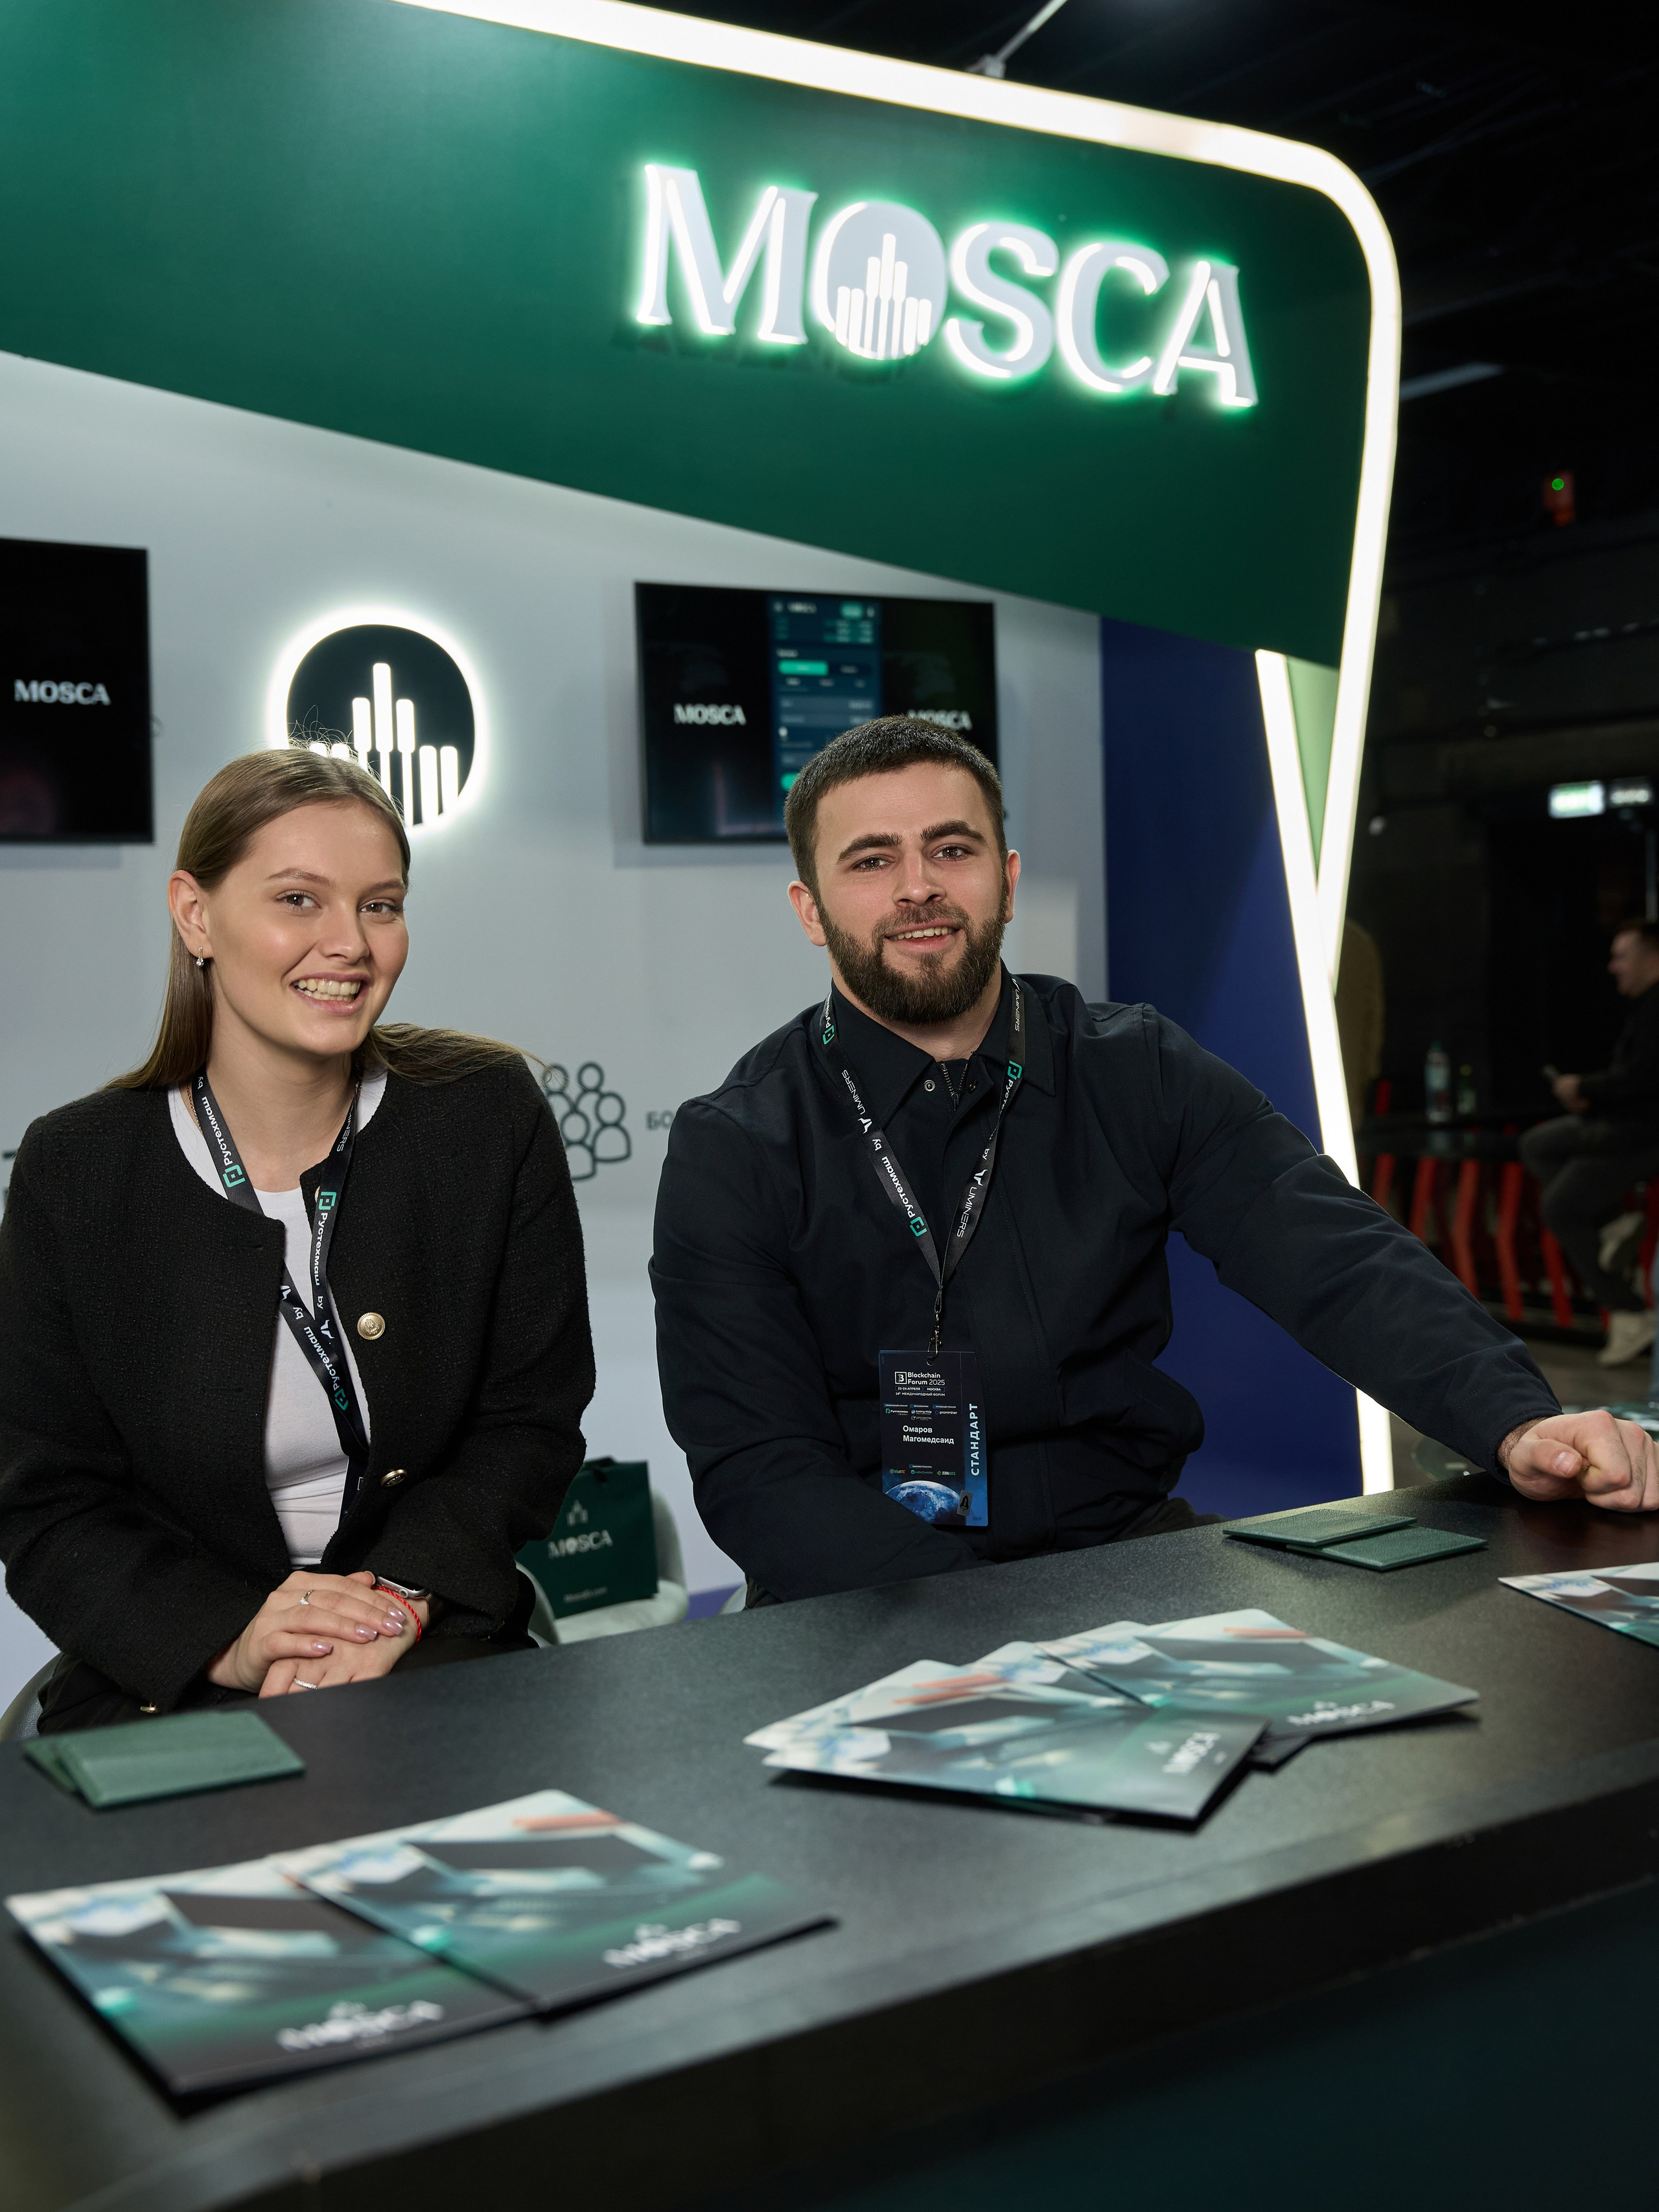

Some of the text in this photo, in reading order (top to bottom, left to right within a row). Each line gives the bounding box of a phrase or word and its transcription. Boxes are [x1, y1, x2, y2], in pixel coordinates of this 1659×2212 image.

[637, 163, 1259, 407] MOSCA
[14, 679, 111, 705] MOSCA
[674, 703, 747, 725] MOSCA
[197, 1077, 233, 1166] Рустехмаш by
[842, 1069, 916, 1218] Рустехмаш by UMINERS
[982, 1148, 990, 1160] by
[957, 1187, 977, 1238] UMINERS
[314, 1213, 328, 1309] Рустехмаш by
[293, 1307, 340, 1391] Рустехмаш by
[903, 1425, 933, 1434] Омаров
[903, 1435, 955, 1445] Магомедсаид
[969, 1403, 980, 1476] СТАНДАРТ
[548, 1530, 613, 1559] MOSCA
